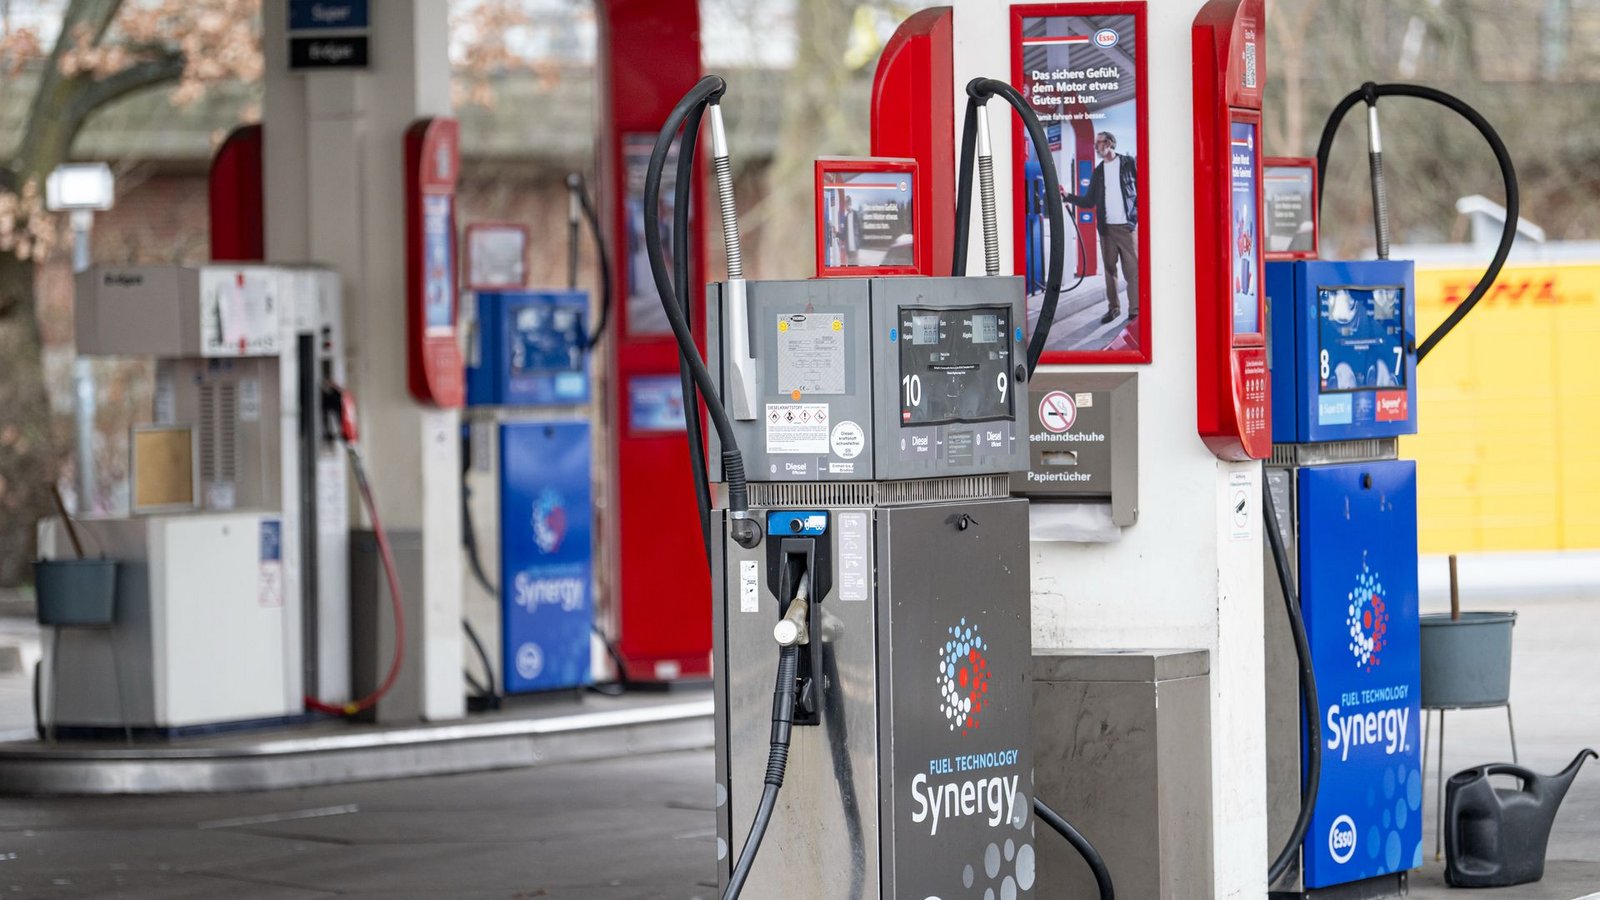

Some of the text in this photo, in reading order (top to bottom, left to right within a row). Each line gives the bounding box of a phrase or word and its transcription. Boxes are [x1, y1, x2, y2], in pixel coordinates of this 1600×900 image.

[1098, 34, 1114, 42] Esso
[1032, 67, 1120, 80] Das sichere Gefühl,
[1032, 82, 1118, 93] dem Motor etwas
[1032, 94, 1098, 106] Gutes zu tun.
[1320, 349, 1330, 380] 8
[1393, 346, 1402, 376] 7
[902, 374, 922, 407] 10
[996, 372, 1008, 404] 9
[912, 436, 928, 446] Diesel
[987, 431, 1002, 441] Diesel
[1030, 432, 1105, 441] selhandschuhe
[1028, 472, 1091, 483] Papiertücher
[515, 570, 584, 614] Synergy
[1342, 685, 1409, 706] FUEL TECHNOLOGY
[1327, 704, 1409, 762] Synergy
[930, 750, 1018, 775] FUEL TECHNOLOGY
[912, 773, 1018, 836] Synergy
[1333, 828, 1353, 849] Esso
